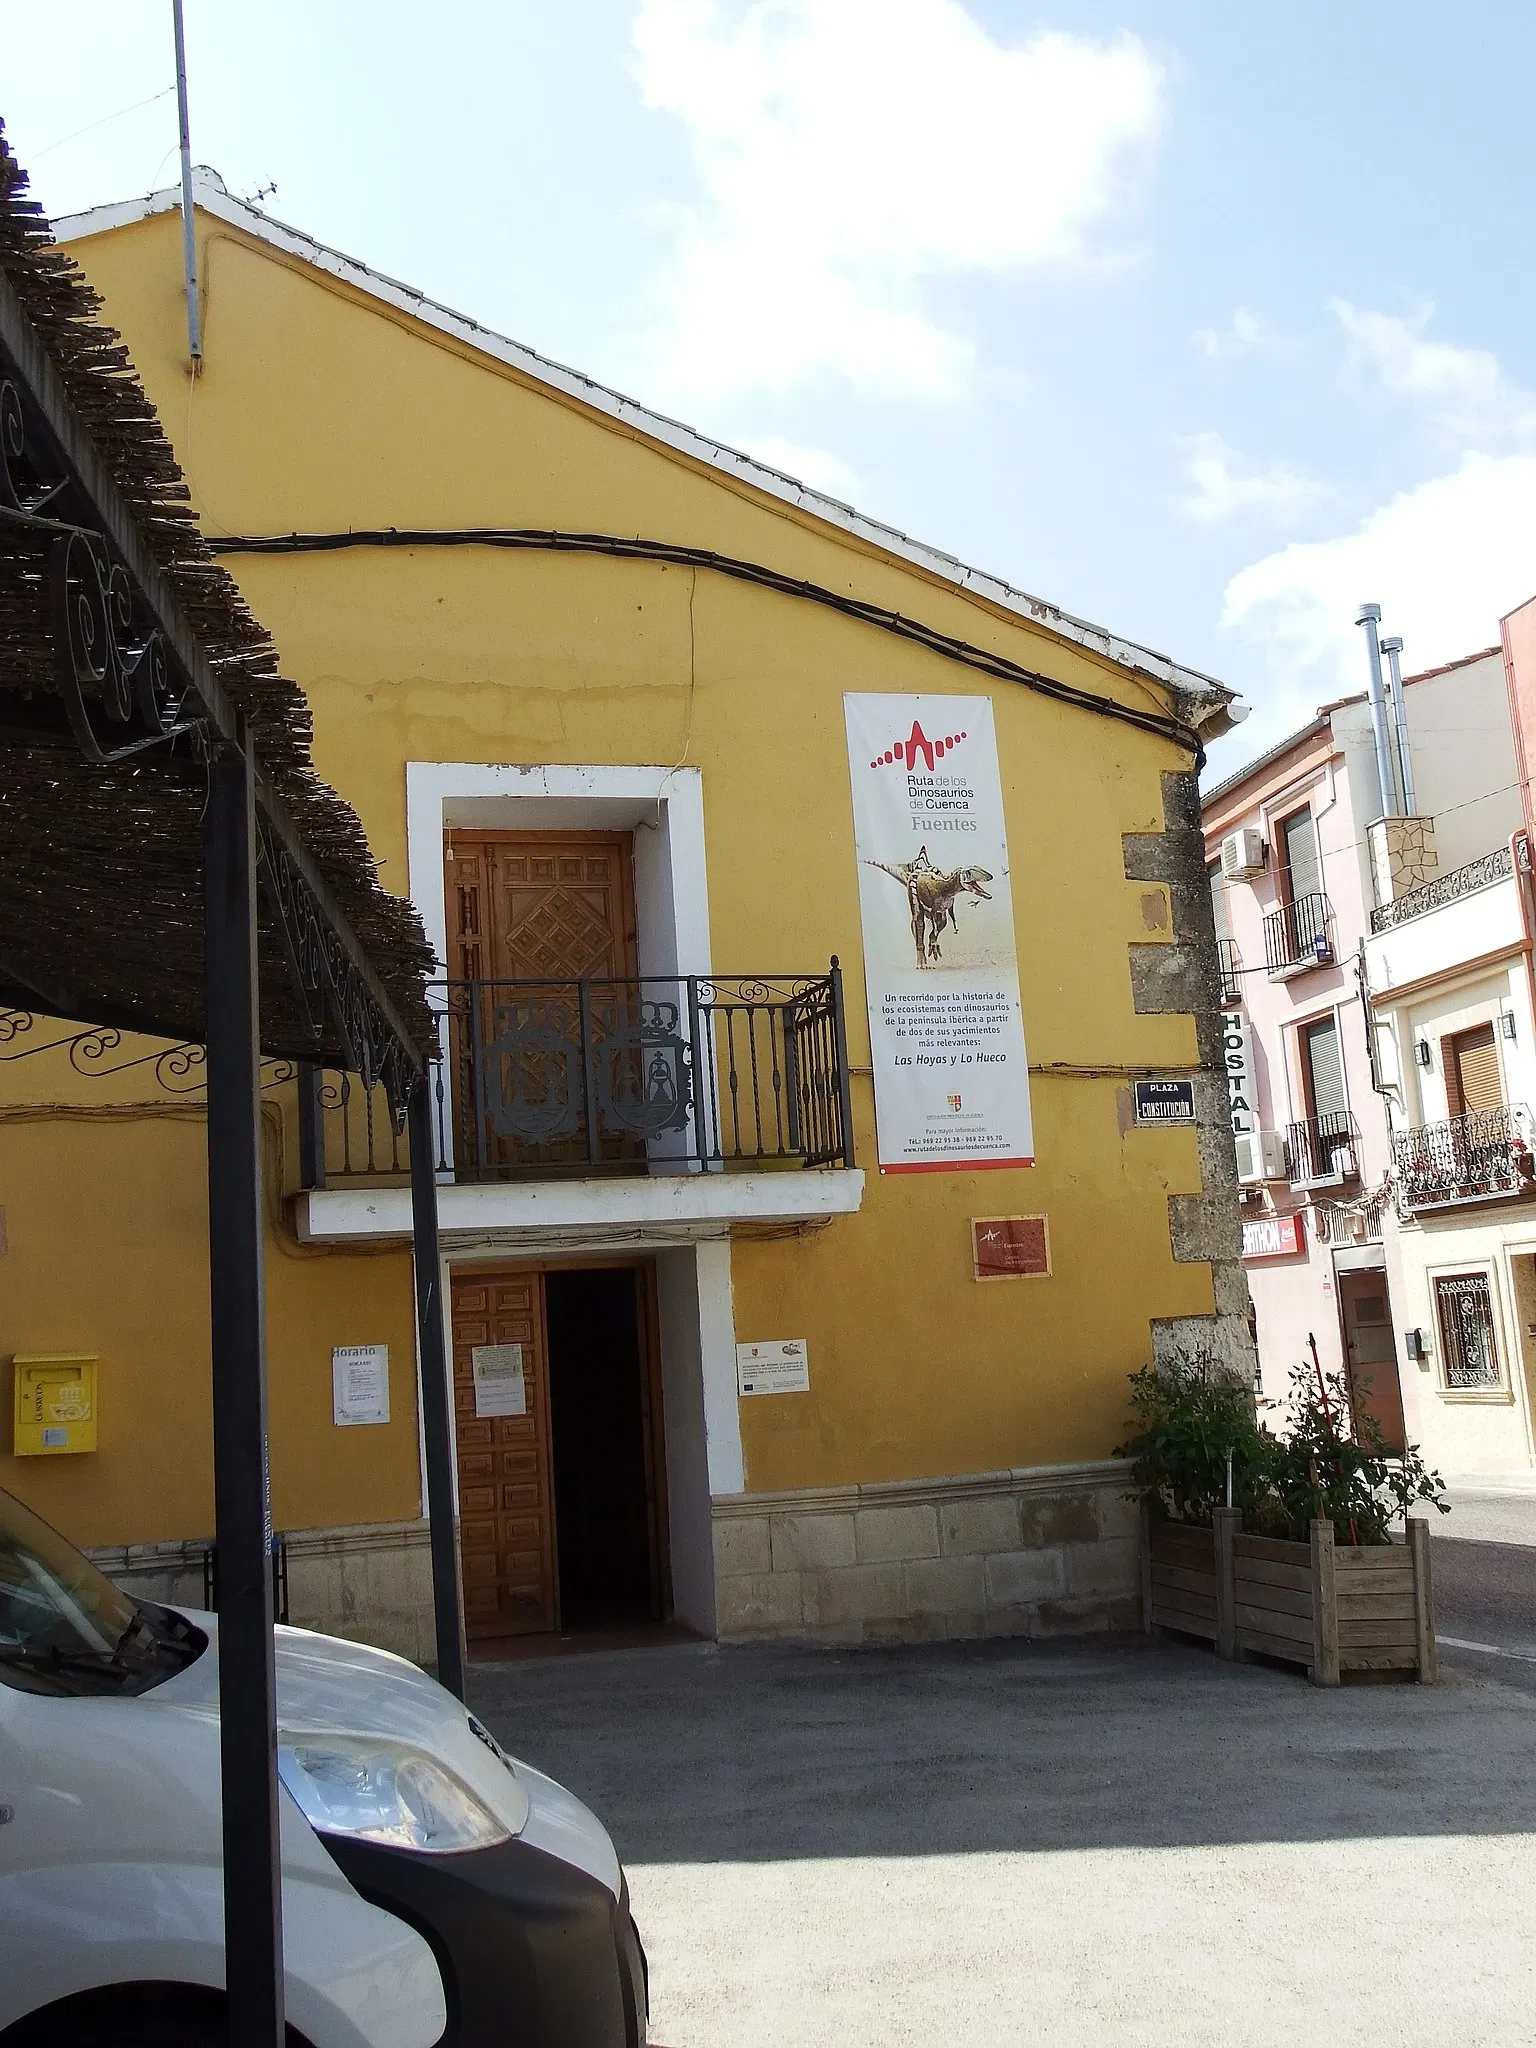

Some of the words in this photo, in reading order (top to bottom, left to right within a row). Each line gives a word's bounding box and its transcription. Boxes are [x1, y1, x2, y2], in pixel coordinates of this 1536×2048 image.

[907, 775, 934, 786] Ruta
[935, 776, 950, 787] de
[951, 775, 967, 787] los
[908, 786, 974, 798] Dinosaurios
[909, 799, 924, 809] de
[925, 798, 969, 810] Cuenca
[911, 816, 977, 831] Fuentes
[885, 994, 897, 1002] Un
[899, 993, 934, 1002] recorrido
[937, 993, 950, 1003] por
[952, 993, 960, 1001] la
[962, 992, 993, 1001] historia
[995, 992, 1005, 1000] de
[882, 1005, 895, 1014] los
[897, 1004, 945, 1013] ecosistemas
[964, 1003, 1010, 1012] dinosaurios
[885, 1017, 895, 1025] de
[898, 1016, 906, 1025] la
[949, 1014, 977, 1024] ibérica
[986, 1014, 1009, 1024] partir
[896, 1028, 906, 1036] de
[908, 1027, 923, 1036] dos
[925, 1027, 935, 1036] de
[937, 1028, 950, 1036] sus
[952, 1026, 1001, 1037] yacimientos
[918, 1039, 935, 1047] más
[936, 1038, 981, 1047] relevantes:
[894, 1055, 912, 1065] Las
[916, 1054, 947, 1067] Hoyas
[950, 1055, 957, 1066] y
[960, 1053, 973, 1063] Lo
[976, 1052, 1007, 1063] Hueco
[1222, 1014, 1251, 1132] HOSTAL
[1150, 1084, 1179, 1092] PLAZA
[1141, 1099, 1191, 1117] CONSTITUCIÓN
[903, 1143, 1011, 1153] www.rutadelosdinosauriosdecuenca.com
[333, 1346, 376, 1358] Horario
